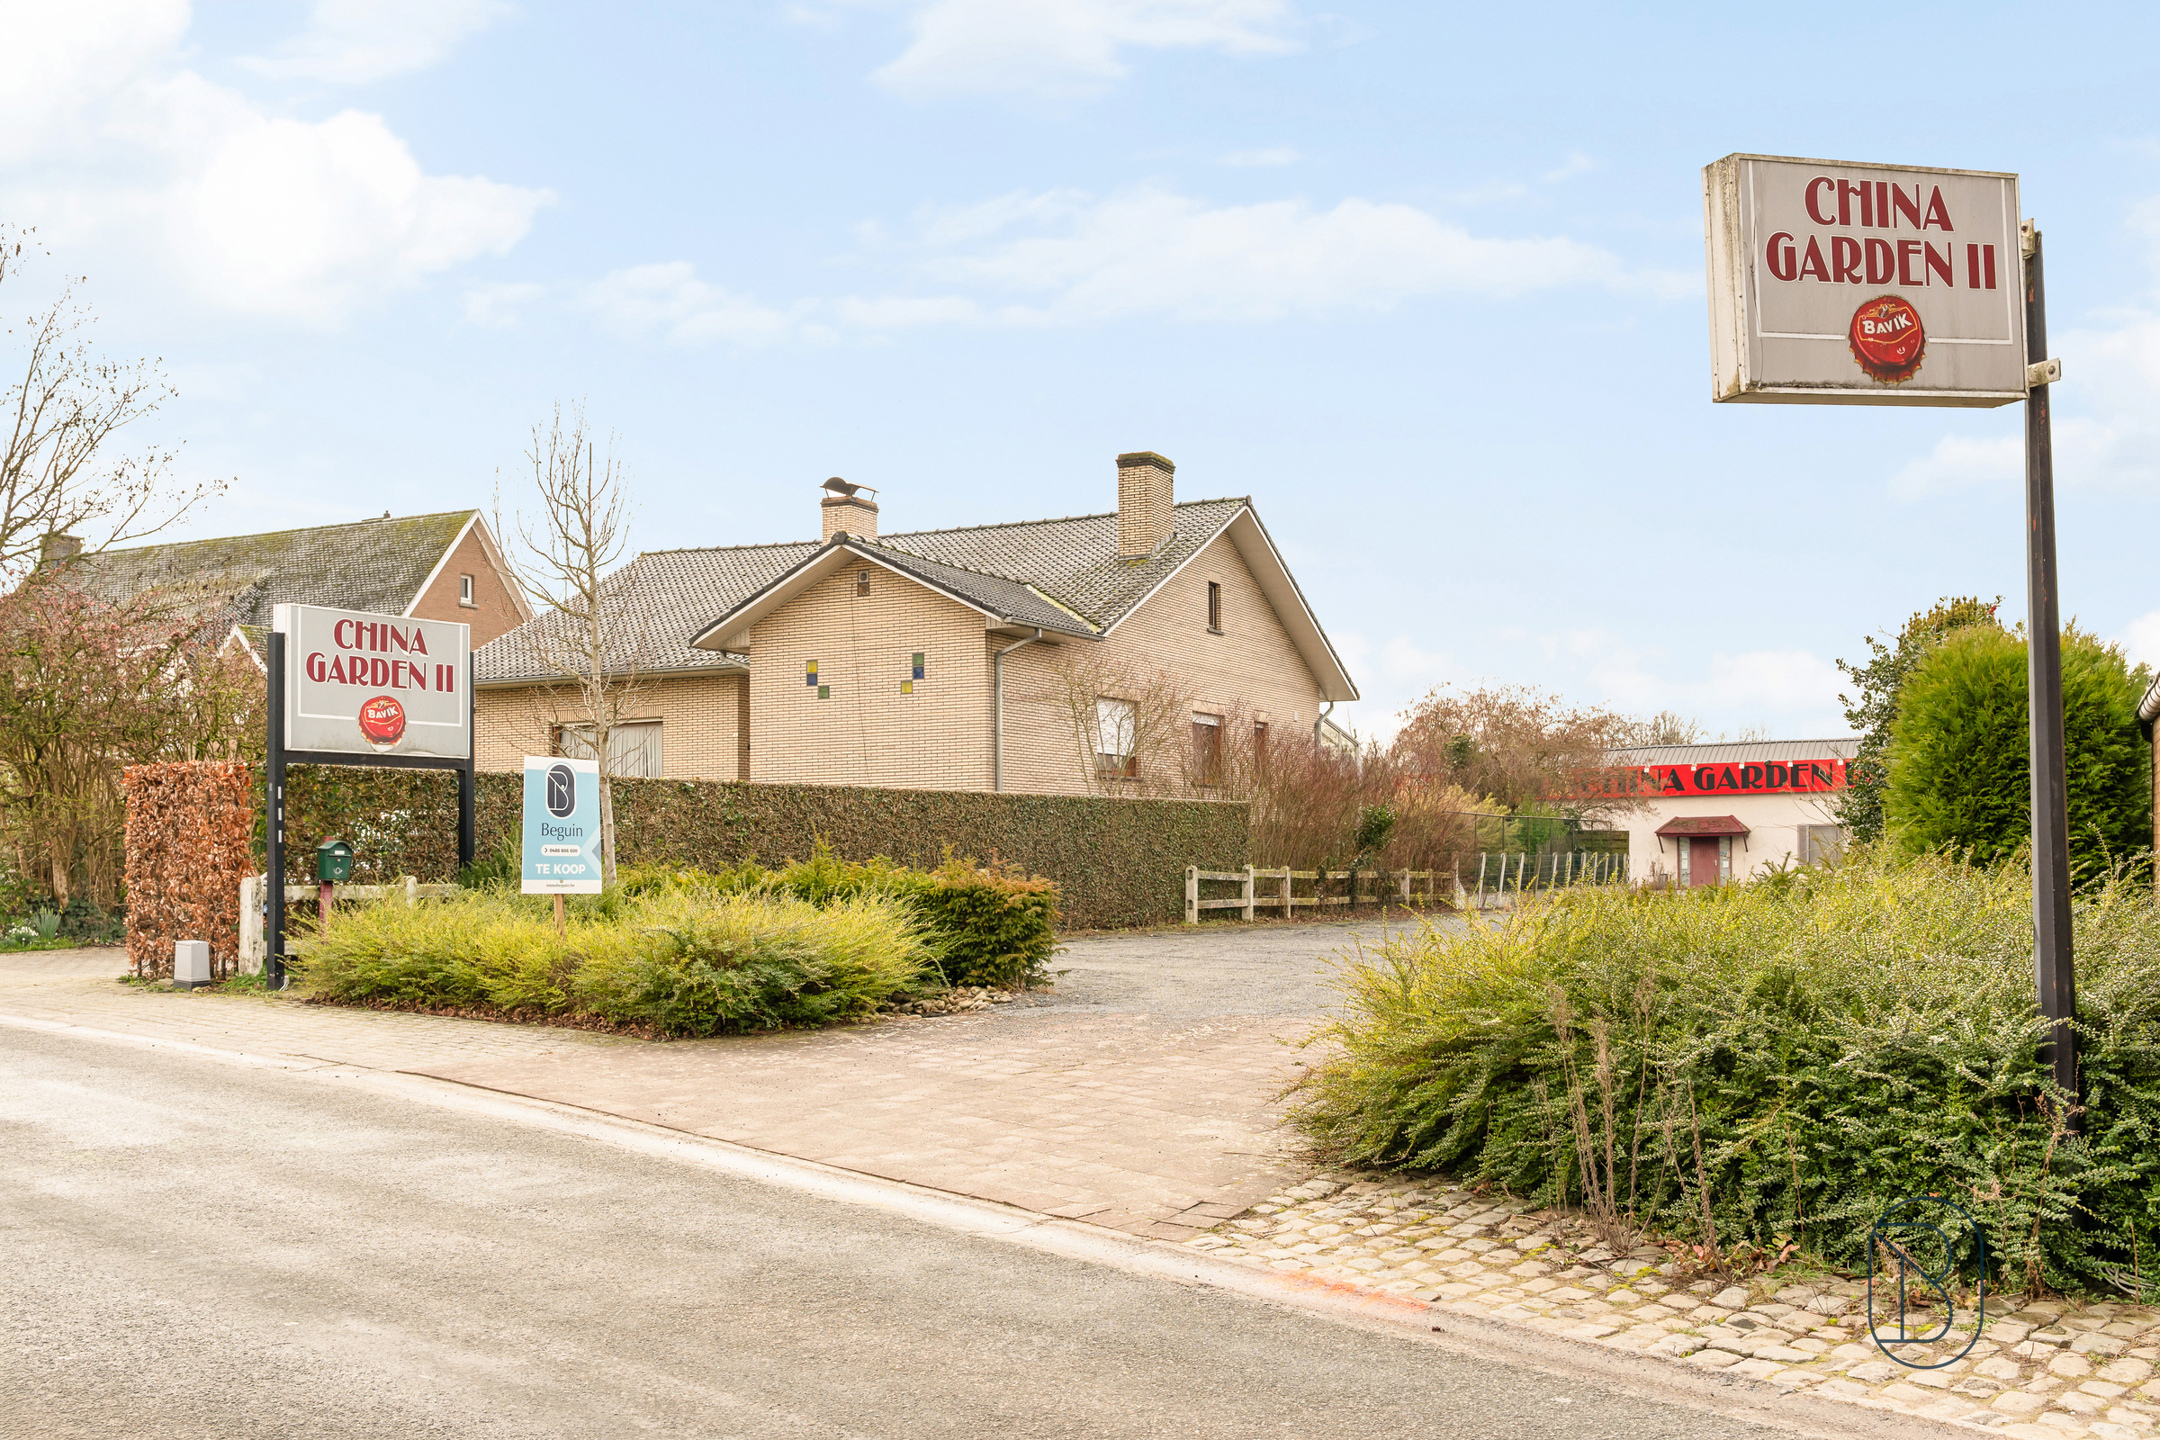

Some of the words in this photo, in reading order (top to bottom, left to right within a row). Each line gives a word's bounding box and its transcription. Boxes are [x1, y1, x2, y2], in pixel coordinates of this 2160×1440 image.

[1805, 176, 1954, 231] CHINA
[1766, 232, 1954, 288] GARDEN
[1967, 243, 1997, 289] II
[1862, 313, 1913, 335] BAVIK
[334, 619, 428, 655] CHINA
[306, 653, 426, 690] GARDEN
[436, 664, 454, 693] II
[367, 706, 399, 719] BAVIK
[1693, 763, 1833, 791] GARDEN
[541, 822, 583, 842] Beguin
[535, 863, 551, 875] TE
[553, 863, 586, 875] KOOP
